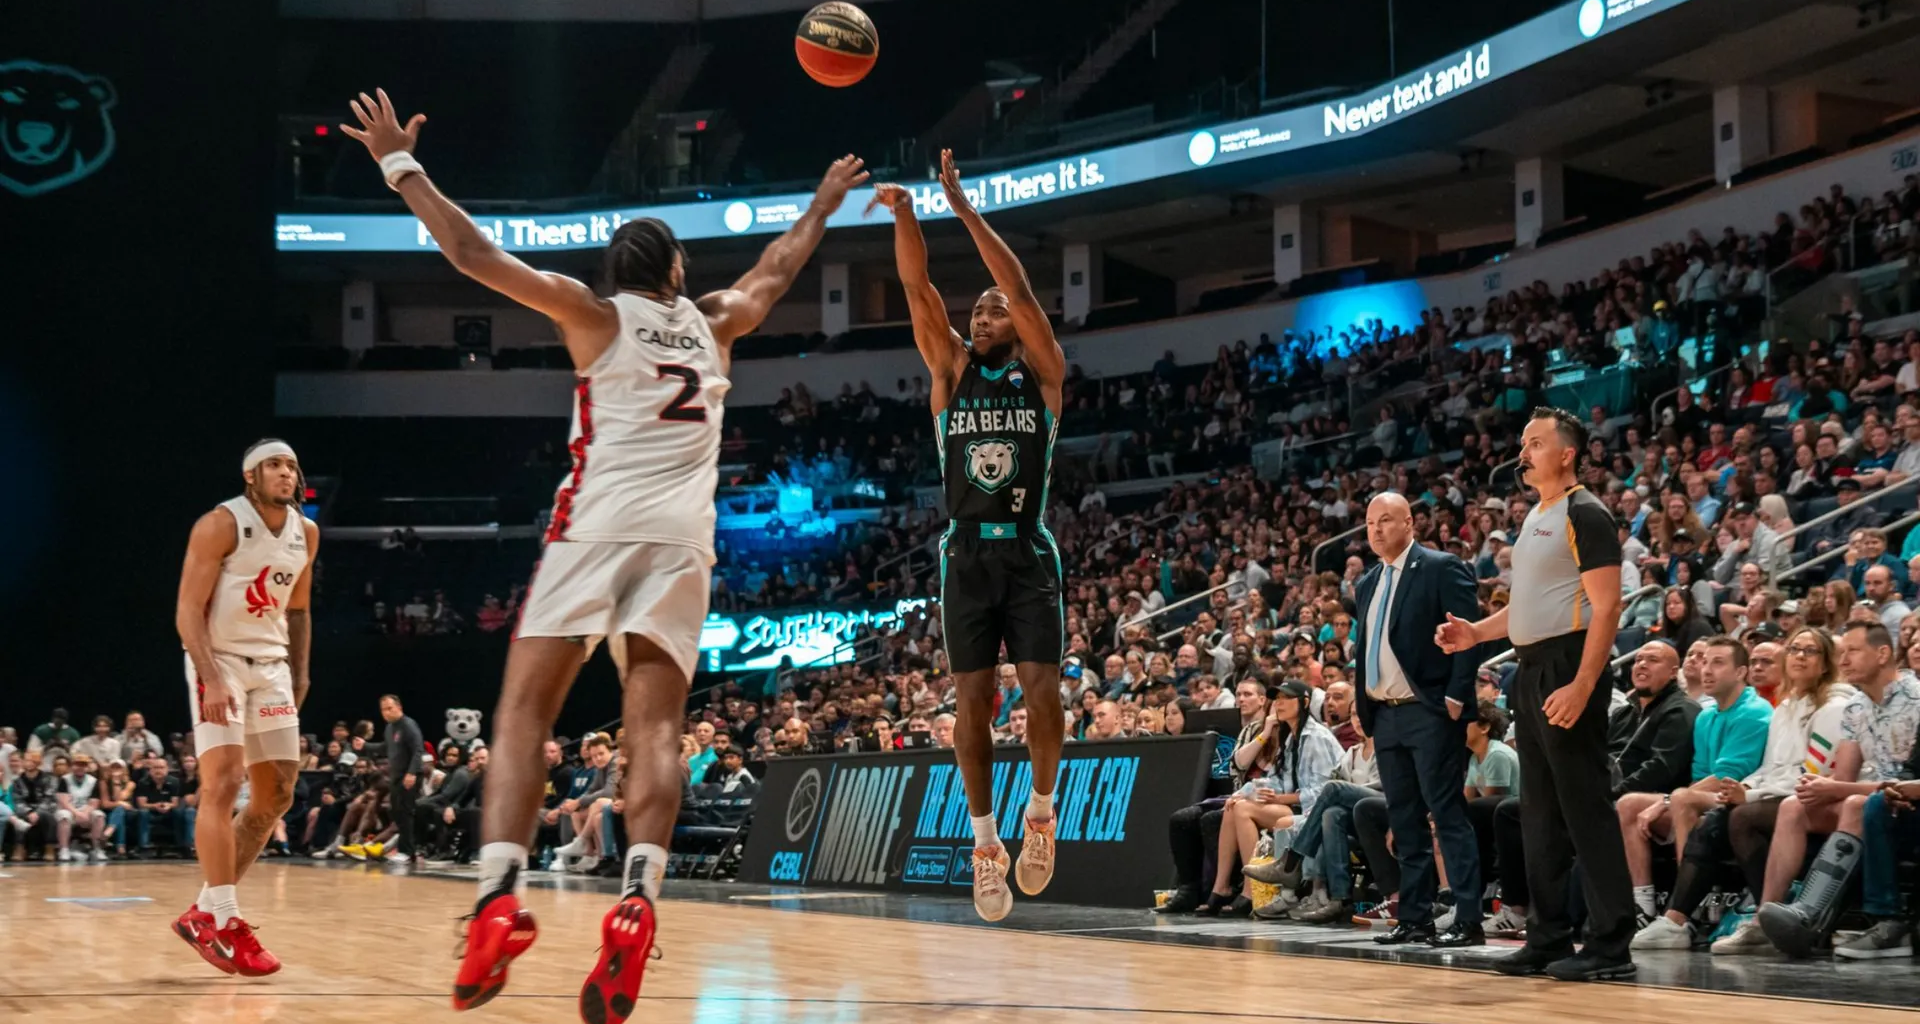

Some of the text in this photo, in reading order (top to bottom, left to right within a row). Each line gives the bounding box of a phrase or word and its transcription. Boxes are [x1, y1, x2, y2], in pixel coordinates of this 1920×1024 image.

[1324, 94, 1392, 136] Never
[1393, 71, 1433, 114] text
[1435, 50, 1473, 97] and
[990, 171, 1056, 205] There
[1059, 162, 1077, 191] it
[1080, 158, 1105, 187] is.
[508, 218, 588, 247] There
[591, 214, 610, 242] it
[656, 363, 707, 423] 2
[959, 396, 1026, 409] WNNIPEG
[948, 409, 1037, 436] SEA BEARS
[1011, 487, 1027, 512] 3
[914, 764, 954, 838] THE
[1055, 758, 1100, 840] THE
[1085, 756, 1140, 842] CEBL
[812, 765, 915, 884] MOBILE
[769, 851, 803, 880] CEBL
[914, 861, 929, 878] App
[928, 861, 946, 876] Store
